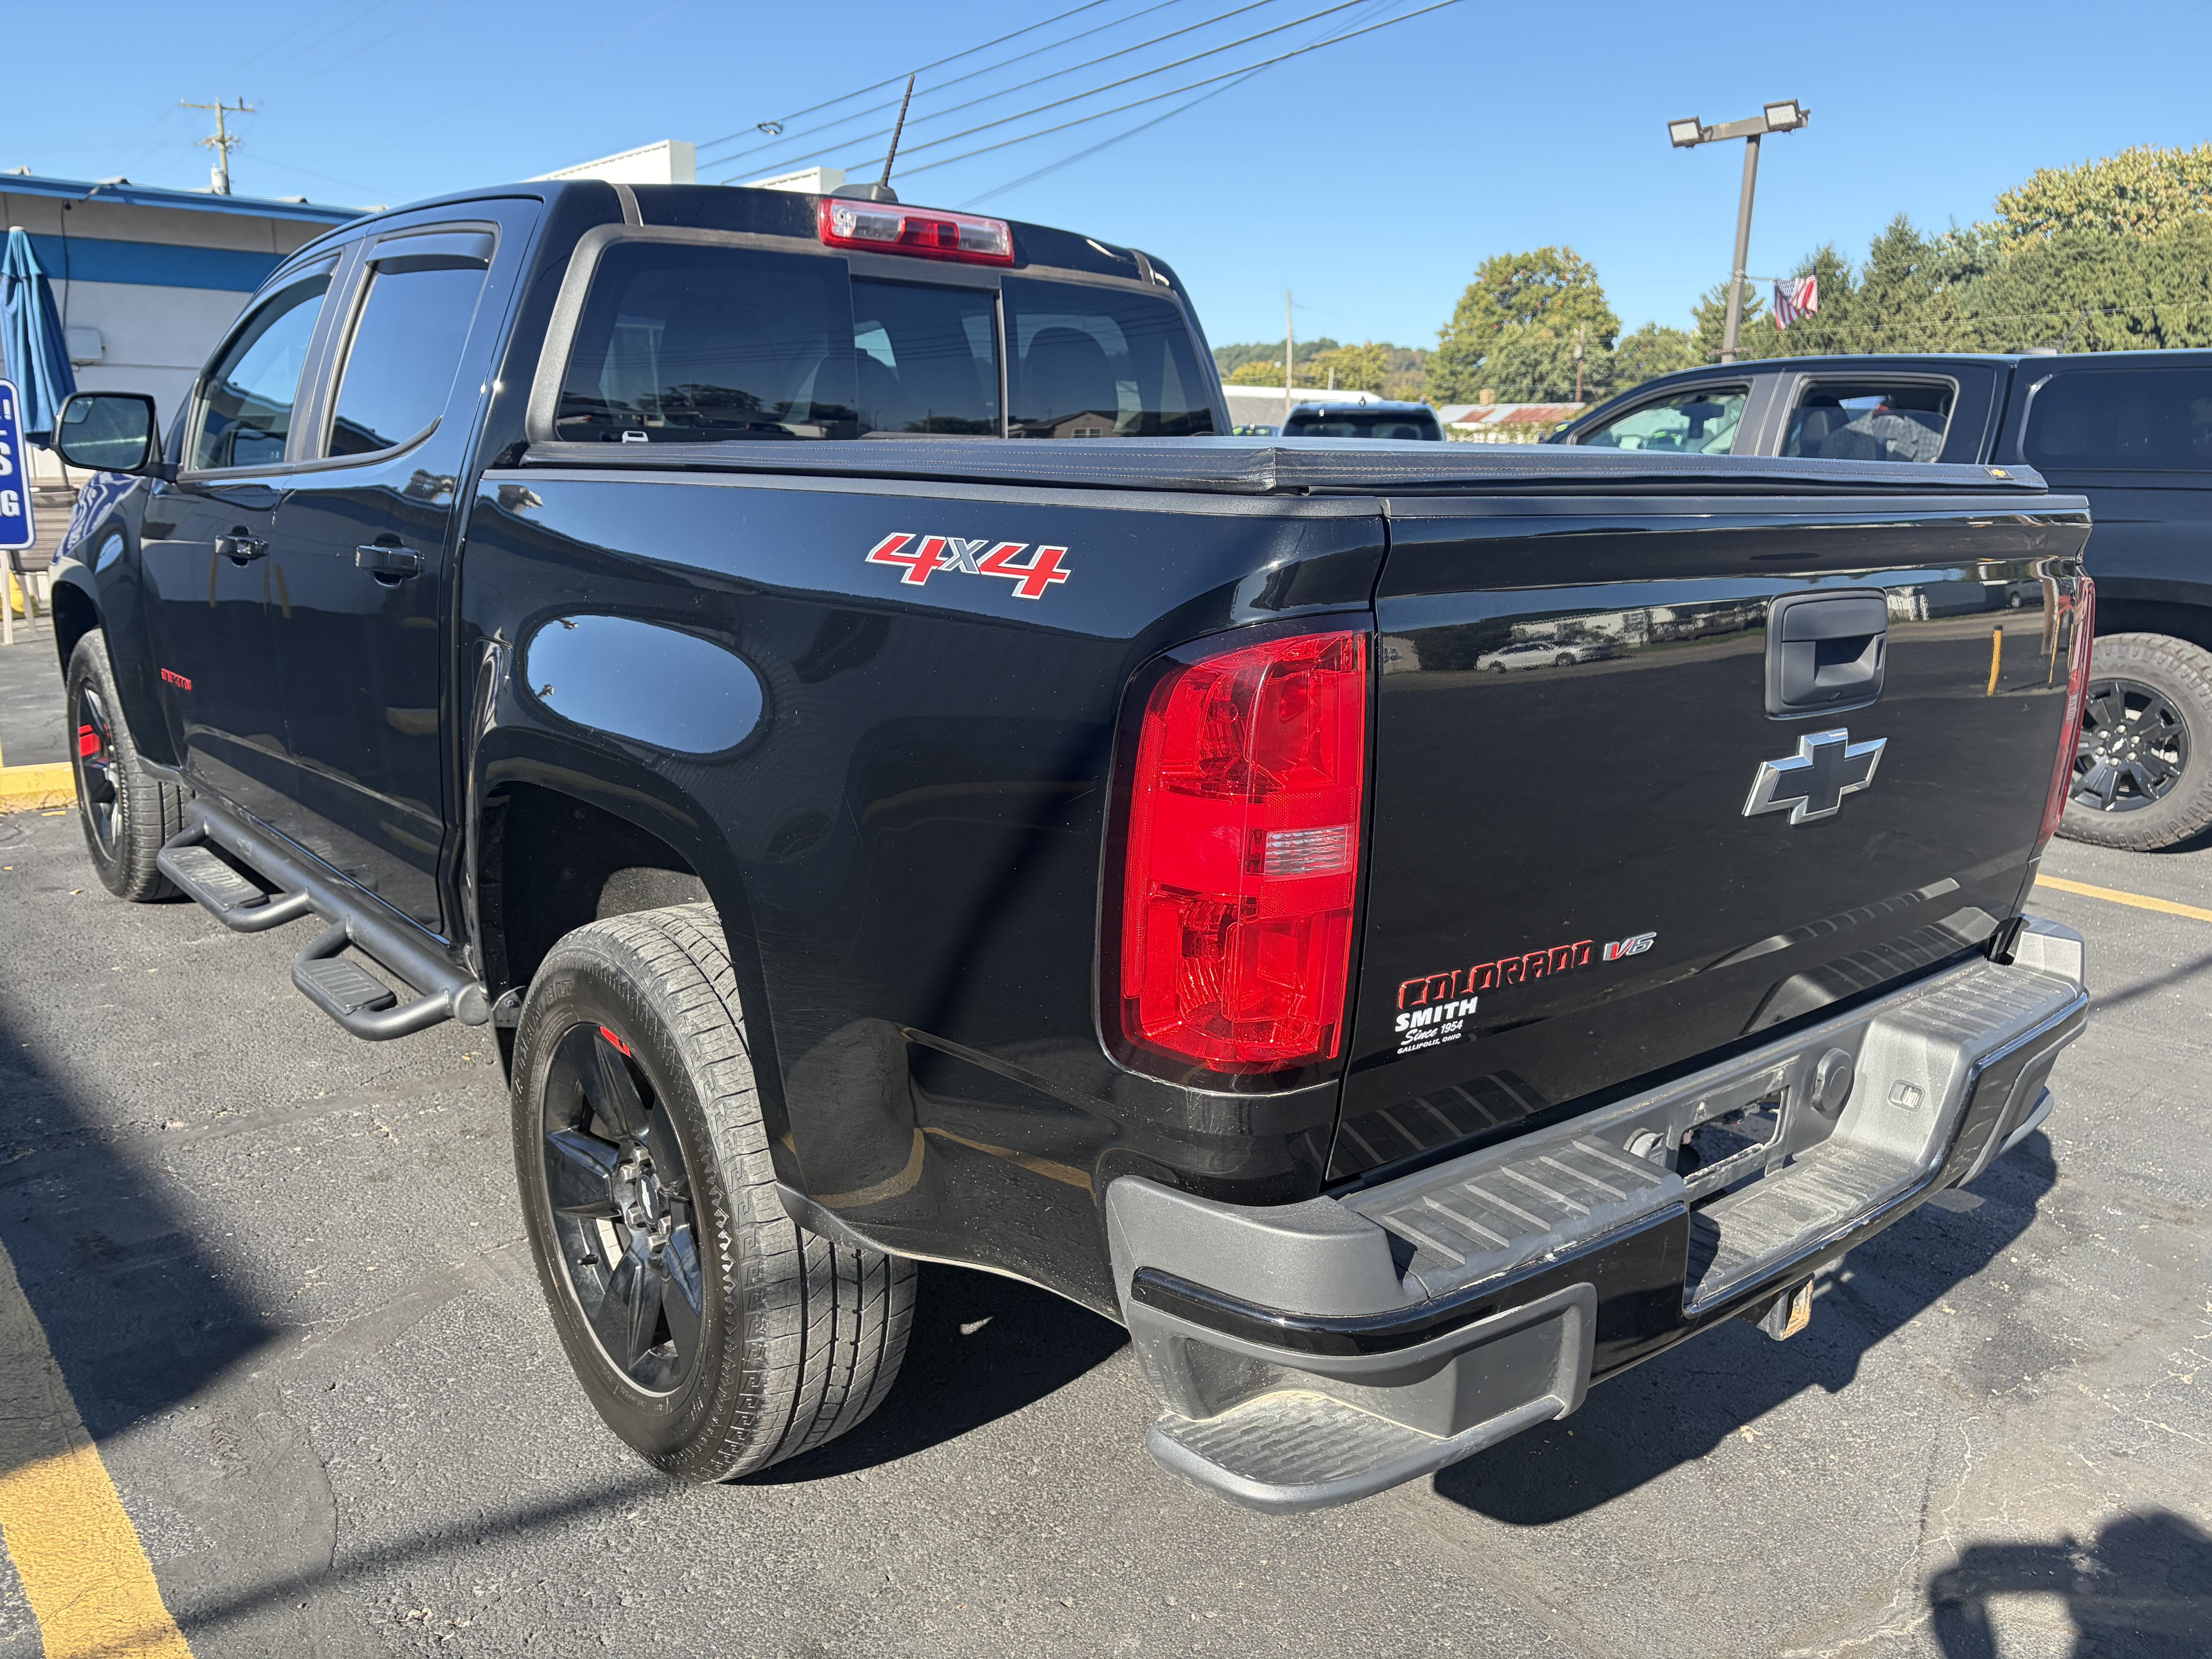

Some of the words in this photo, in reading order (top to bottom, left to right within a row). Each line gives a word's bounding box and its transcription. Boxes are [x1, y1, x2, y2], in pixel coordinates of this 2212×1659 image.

[1398, 939, 1594, 1010] COLORADO
[1603, 931, 1657, 961] V6
[1395, 996, 1478, 1032] SMITH
[1401, 1028, 1438, 1046] Since
[1441, 1019, 1463, 1035] 1954
[1442, 1033, 1462, 1042] OHIO
